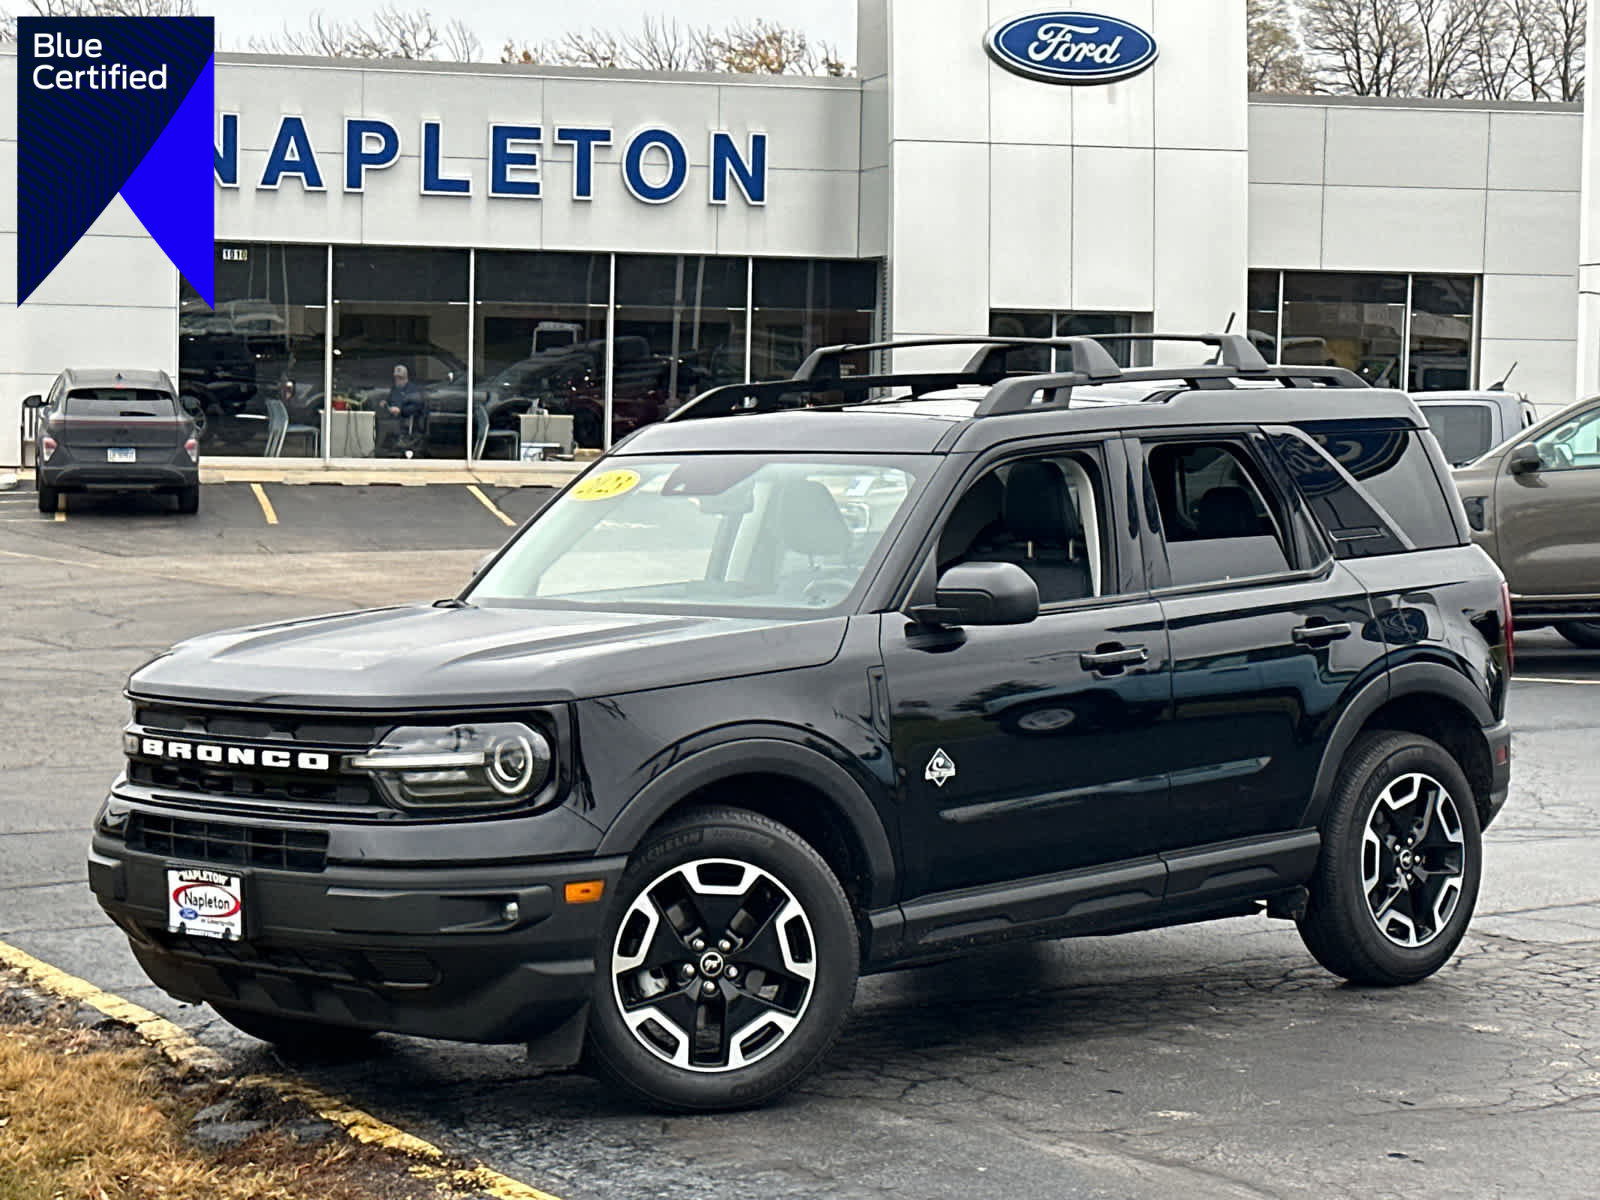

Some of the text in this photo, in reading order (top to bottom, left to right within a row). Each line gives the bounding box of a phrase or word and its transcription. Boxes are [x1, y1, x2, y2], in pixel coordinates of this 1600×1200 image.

[1028, 22, 1124, 65] Ford
[142, 738, 329, 770] BRONCO
[184, 888, 230, 911] Napleton
